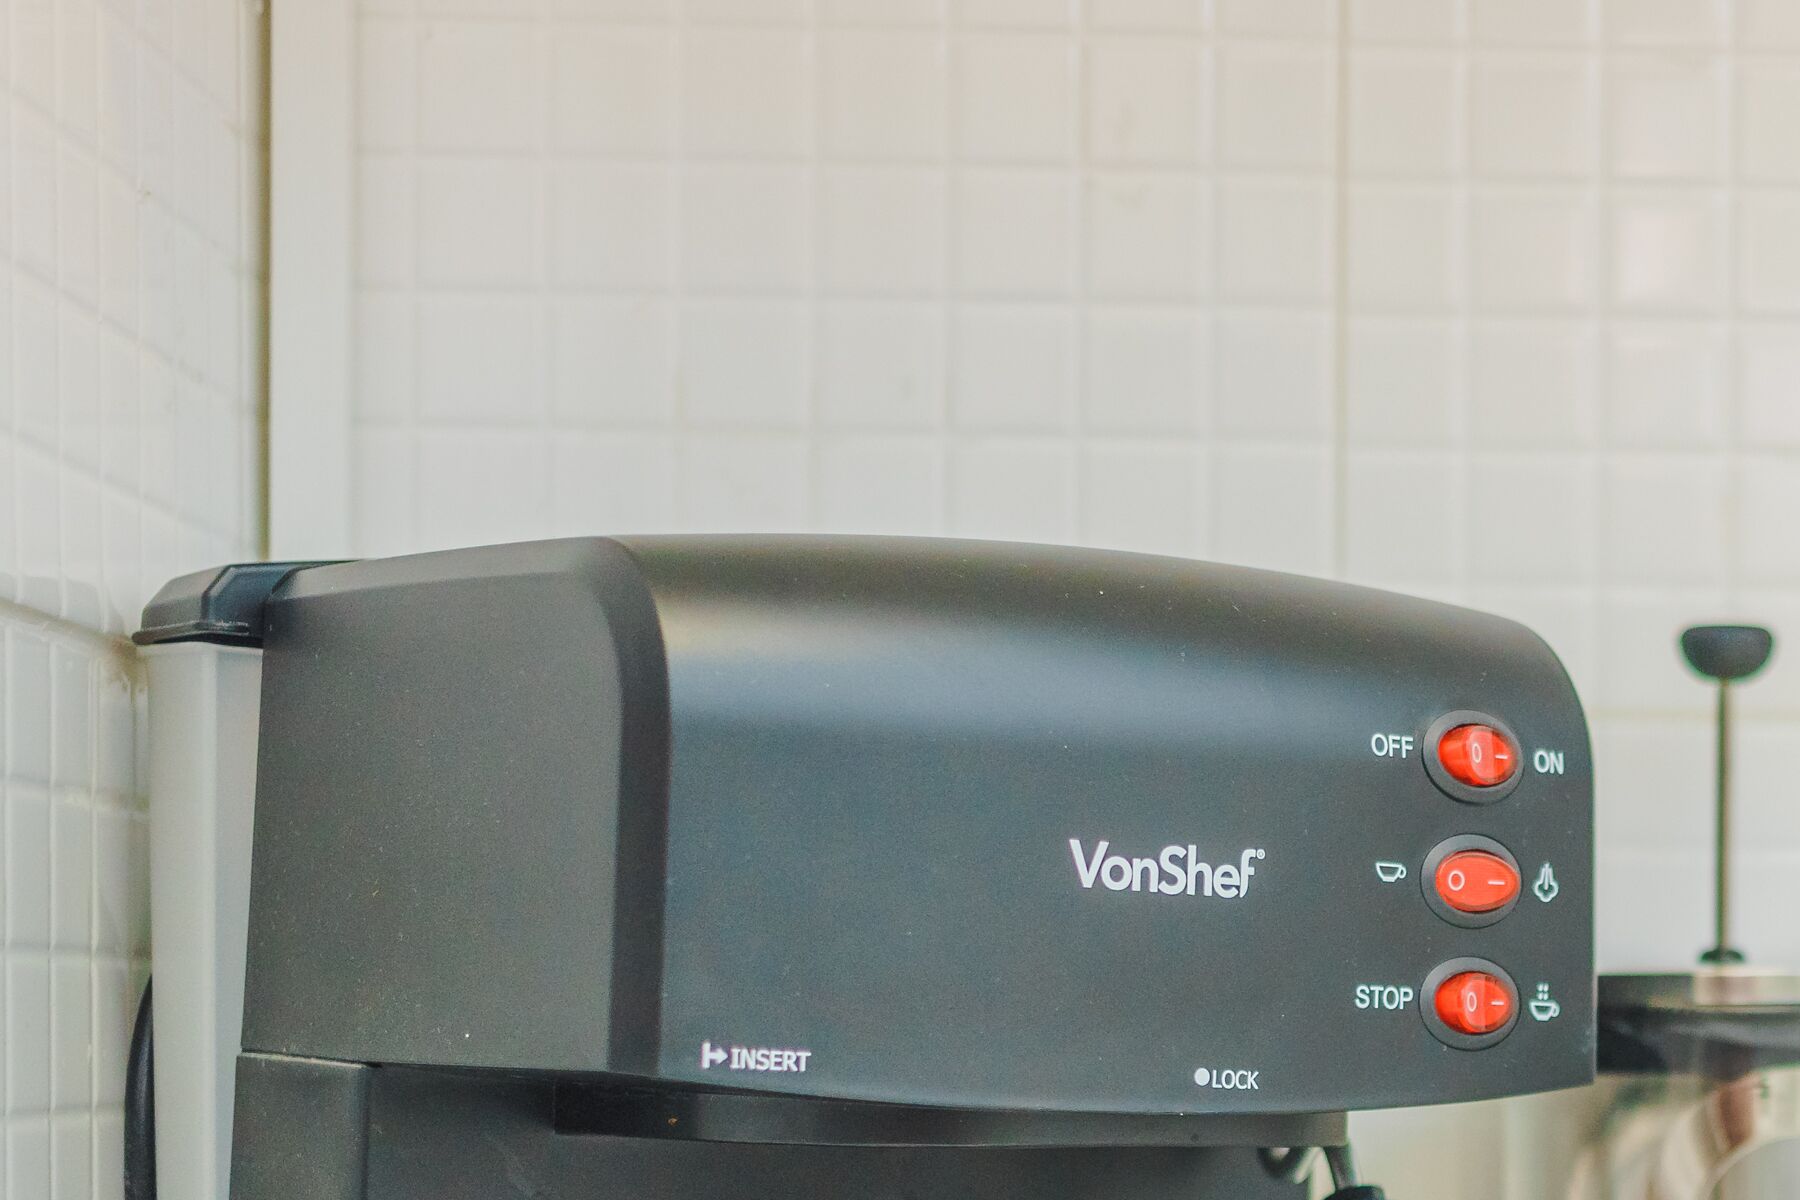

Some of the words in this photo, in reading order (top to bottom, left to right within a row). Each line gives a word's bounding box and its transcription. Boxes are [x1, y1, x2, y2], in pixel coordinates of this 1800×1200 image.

[1371, 734, 1414, 759] OFF
[1533, 750, 1565, 775] ON
[1069, 838, 1257, 899] VonShef
[1355, 986, 1414, 1010] STOP
[730, 1047, 812, 1072] INSERT
[1211, 1069, 1260, 1090] LOCK
